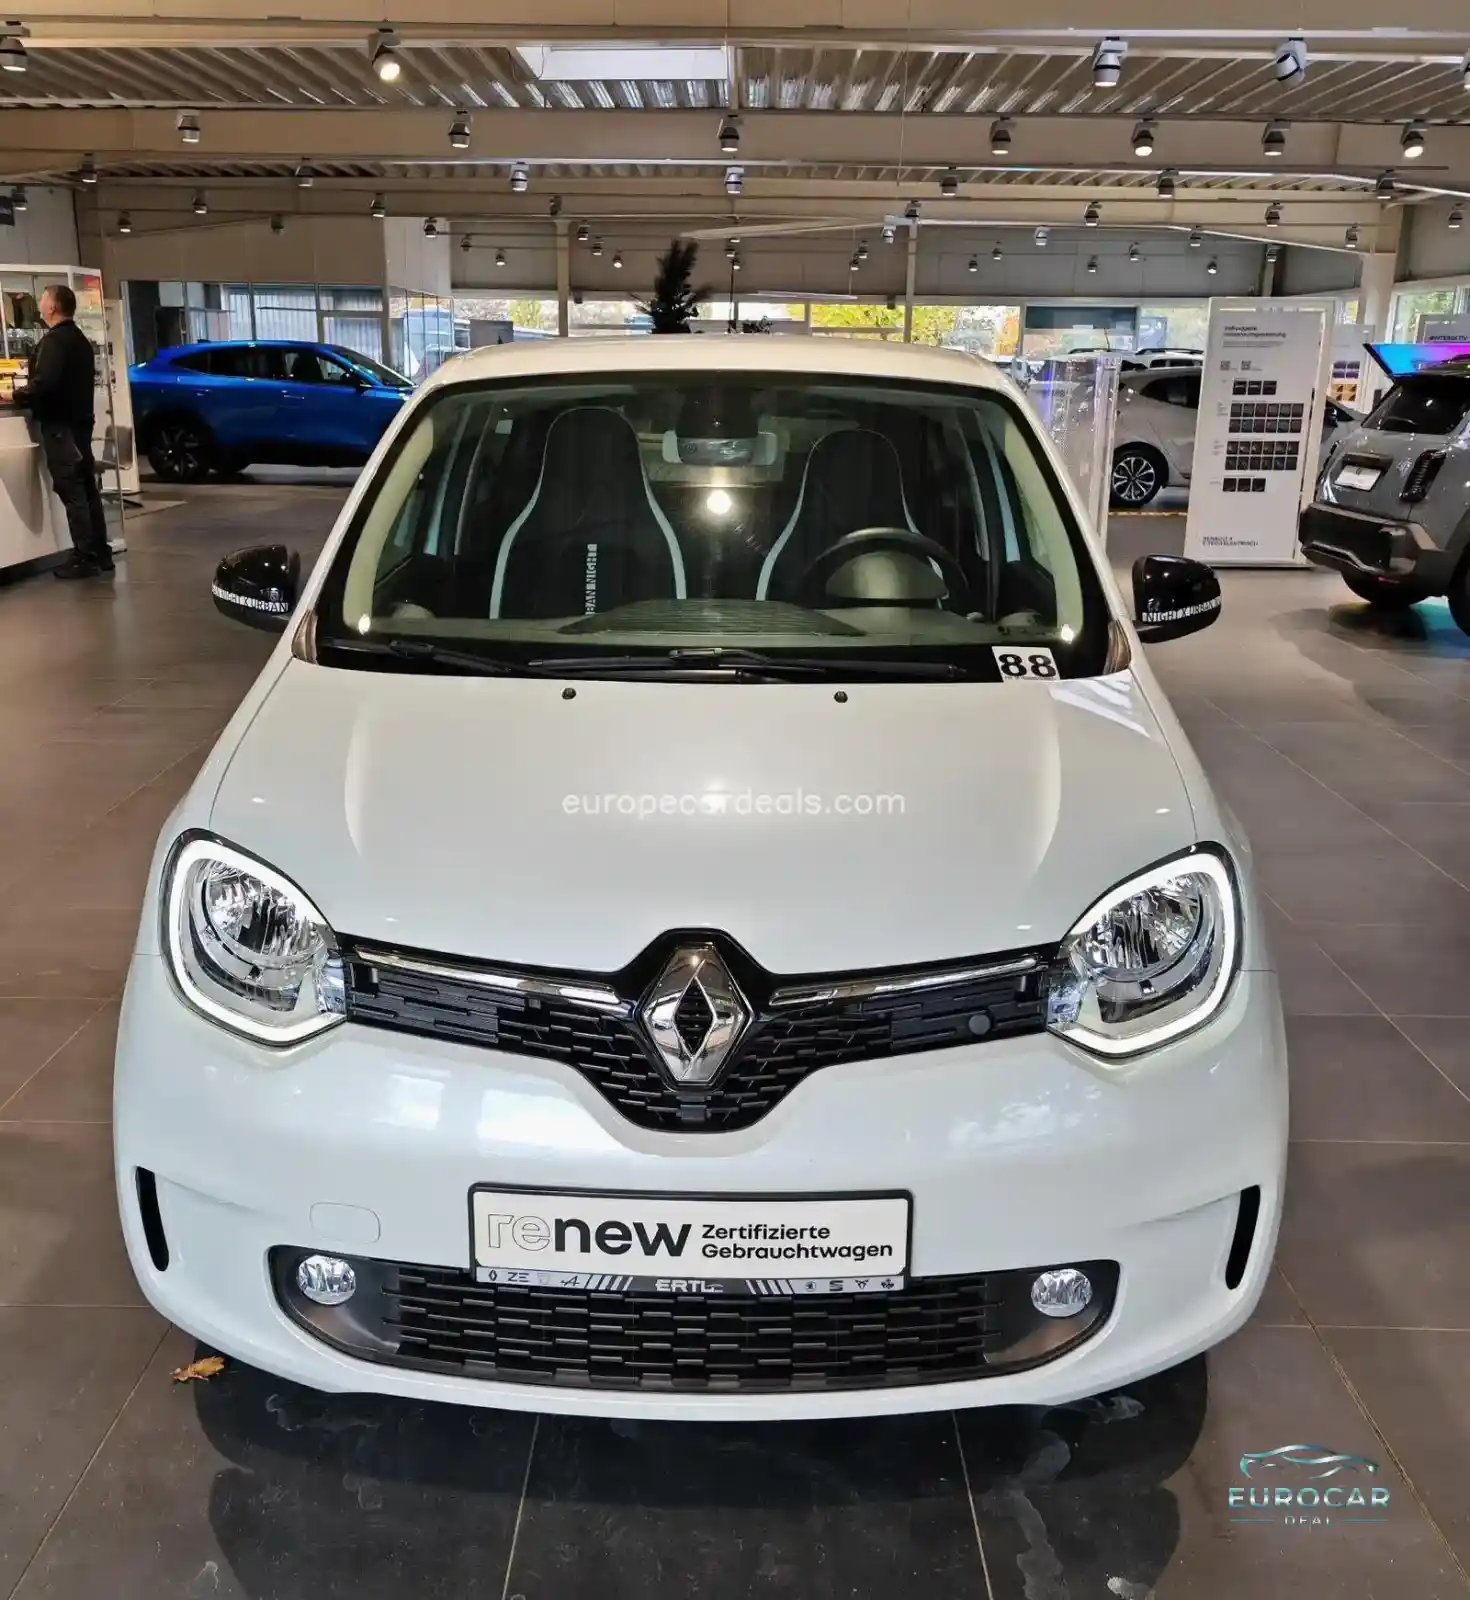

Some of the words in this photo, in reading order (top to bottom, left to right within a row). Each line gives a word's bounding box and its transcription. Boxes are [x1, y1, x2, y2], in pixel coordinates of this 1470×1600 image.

[999, 653, 1057, 678] 88
[488, 1213, 693, 1257] renew
[702, 1224, 831, 1240] Zertifizierte
[702, 1243, 894, 1262] Gebrauchtwagen
